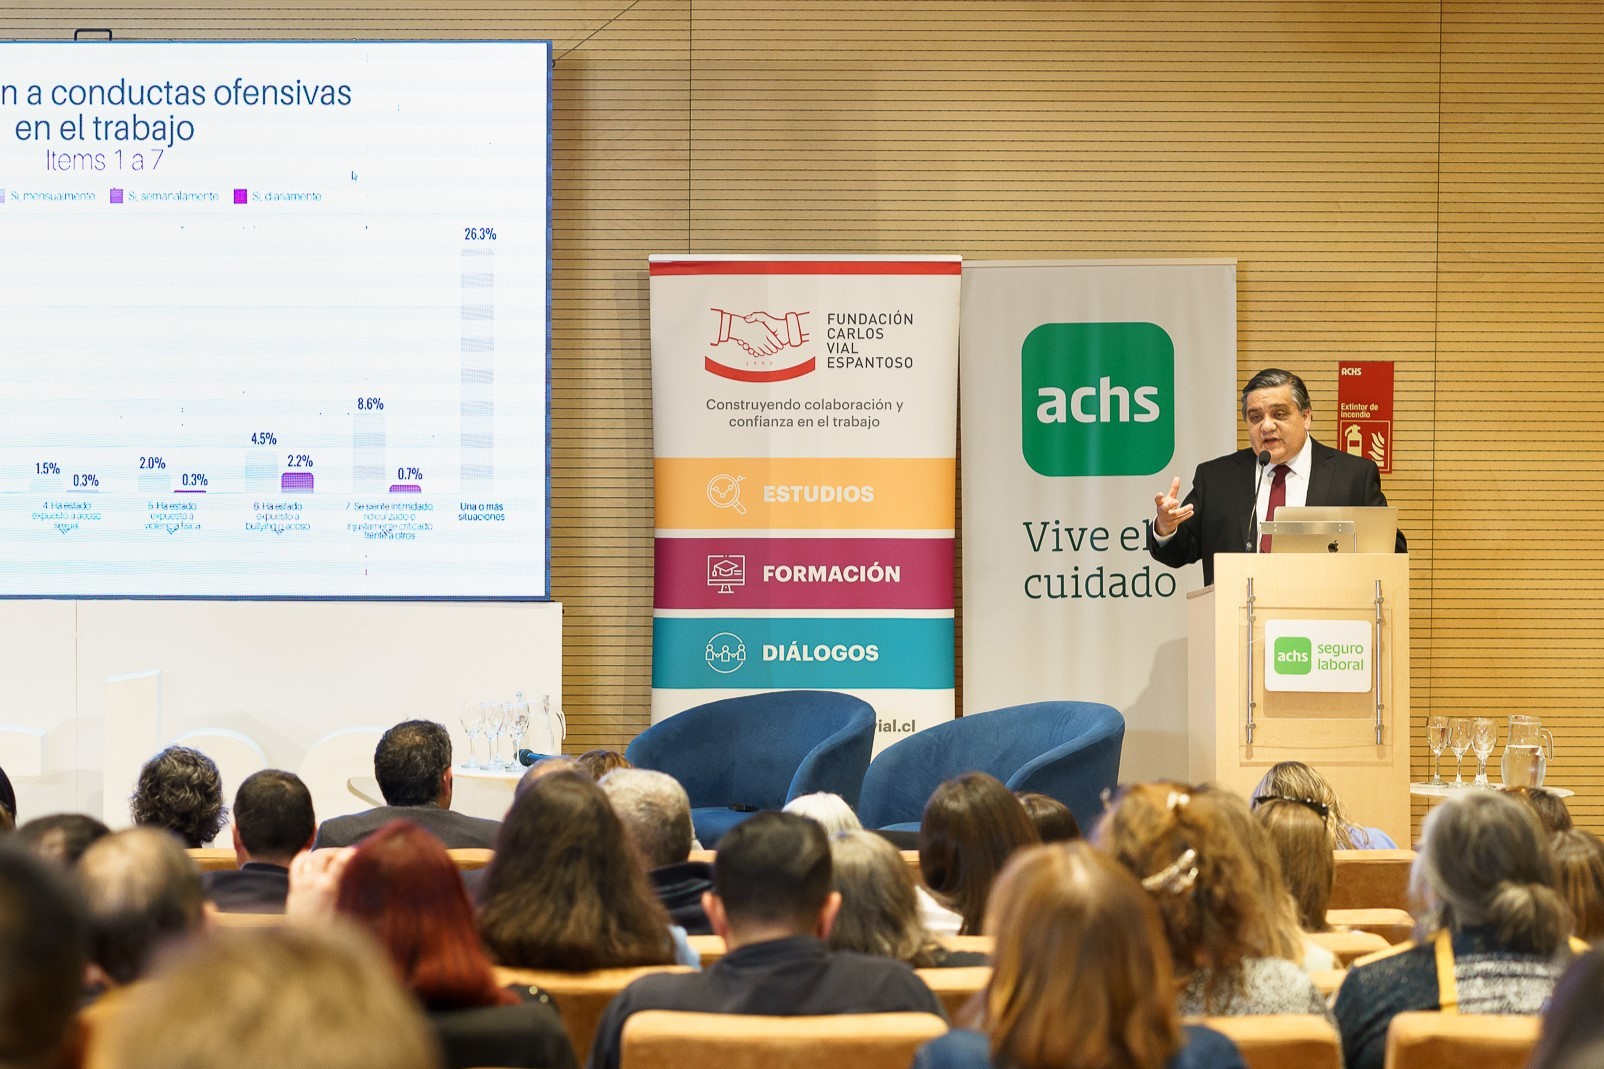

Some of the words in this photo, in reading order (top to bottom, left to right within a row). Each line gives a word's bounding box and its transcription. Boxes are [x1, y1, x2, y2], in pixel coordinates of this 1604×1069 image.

[27, 84, 42, 106] a
[51, 78, 206, 106] conductas
[213, 78, 352, 106] ofensivas
[15, 119, 50, 141] en
[60, 114, 84, 141] el
[92, 114, 195, 148] trabajo
[46, 149, 106, 171] Items
[115, 150, 123, 170] 1
[131, 154, 144, 171] a
[151, 149, 164, 171] 7
[23, 190, 96, 201] mensualmente
[464, 227, 497, 241] 26.3%
[827, 310, 913, 325] FUNDACIÓN
[827, 328, 884, 339] CARLOS
[827, 342, 858, 354] VIAL
[827, 357, 913, 369] ESPANTOSO
[1341, 367, 1362, 376] ACHS
[357, 397, 384, 410] 8.6%
[706, 398, 801, 412] Construyendo
[804, 398, 892, 411] colaboración
[896, 401, 904, 412] y
[1036, 376, 1160, 423] achs
[1341, 403, 1368, 411] Extintor
[1369, 403, 1379, 411] de
[729, 415, 794, 427] confianza
[797, 418, 813, 427] en
[817, 415, 829, 427] el
[832, 415, 880, 428] trabajo
[251, 432, 277, 445] 4.5%
[139, 456, 166, 470] 2.0%
[287, 454, 314, 468] 2.2%
[36, 462, 61, 475] 1.5%
[397, 467, 423, 480] 0.7%
[73, 474, 99, 487] 0.3%
[182, 473, 209, 487] 0.3%
[763, 485, 875, 503] ESTUDIOS
[460, 503, 477, 511] Una
[458, 513, 505, 521] situaciones
[1023, 519, 1110, 552] Vive
[1120, 519, 1150, 551] el
[763, 562, 901, 582] FORMACIÓN
[1024, 566, 1177, 600] cuidado
[762, 641, 880, 662] DIÁLOGOS
[1277, 650, 1309, 662] achs
[1317, 643, 1364, 657] seguro
[1317, 658, 1364, 671] laboral
[876, 719, 916, 732] ial.cl
